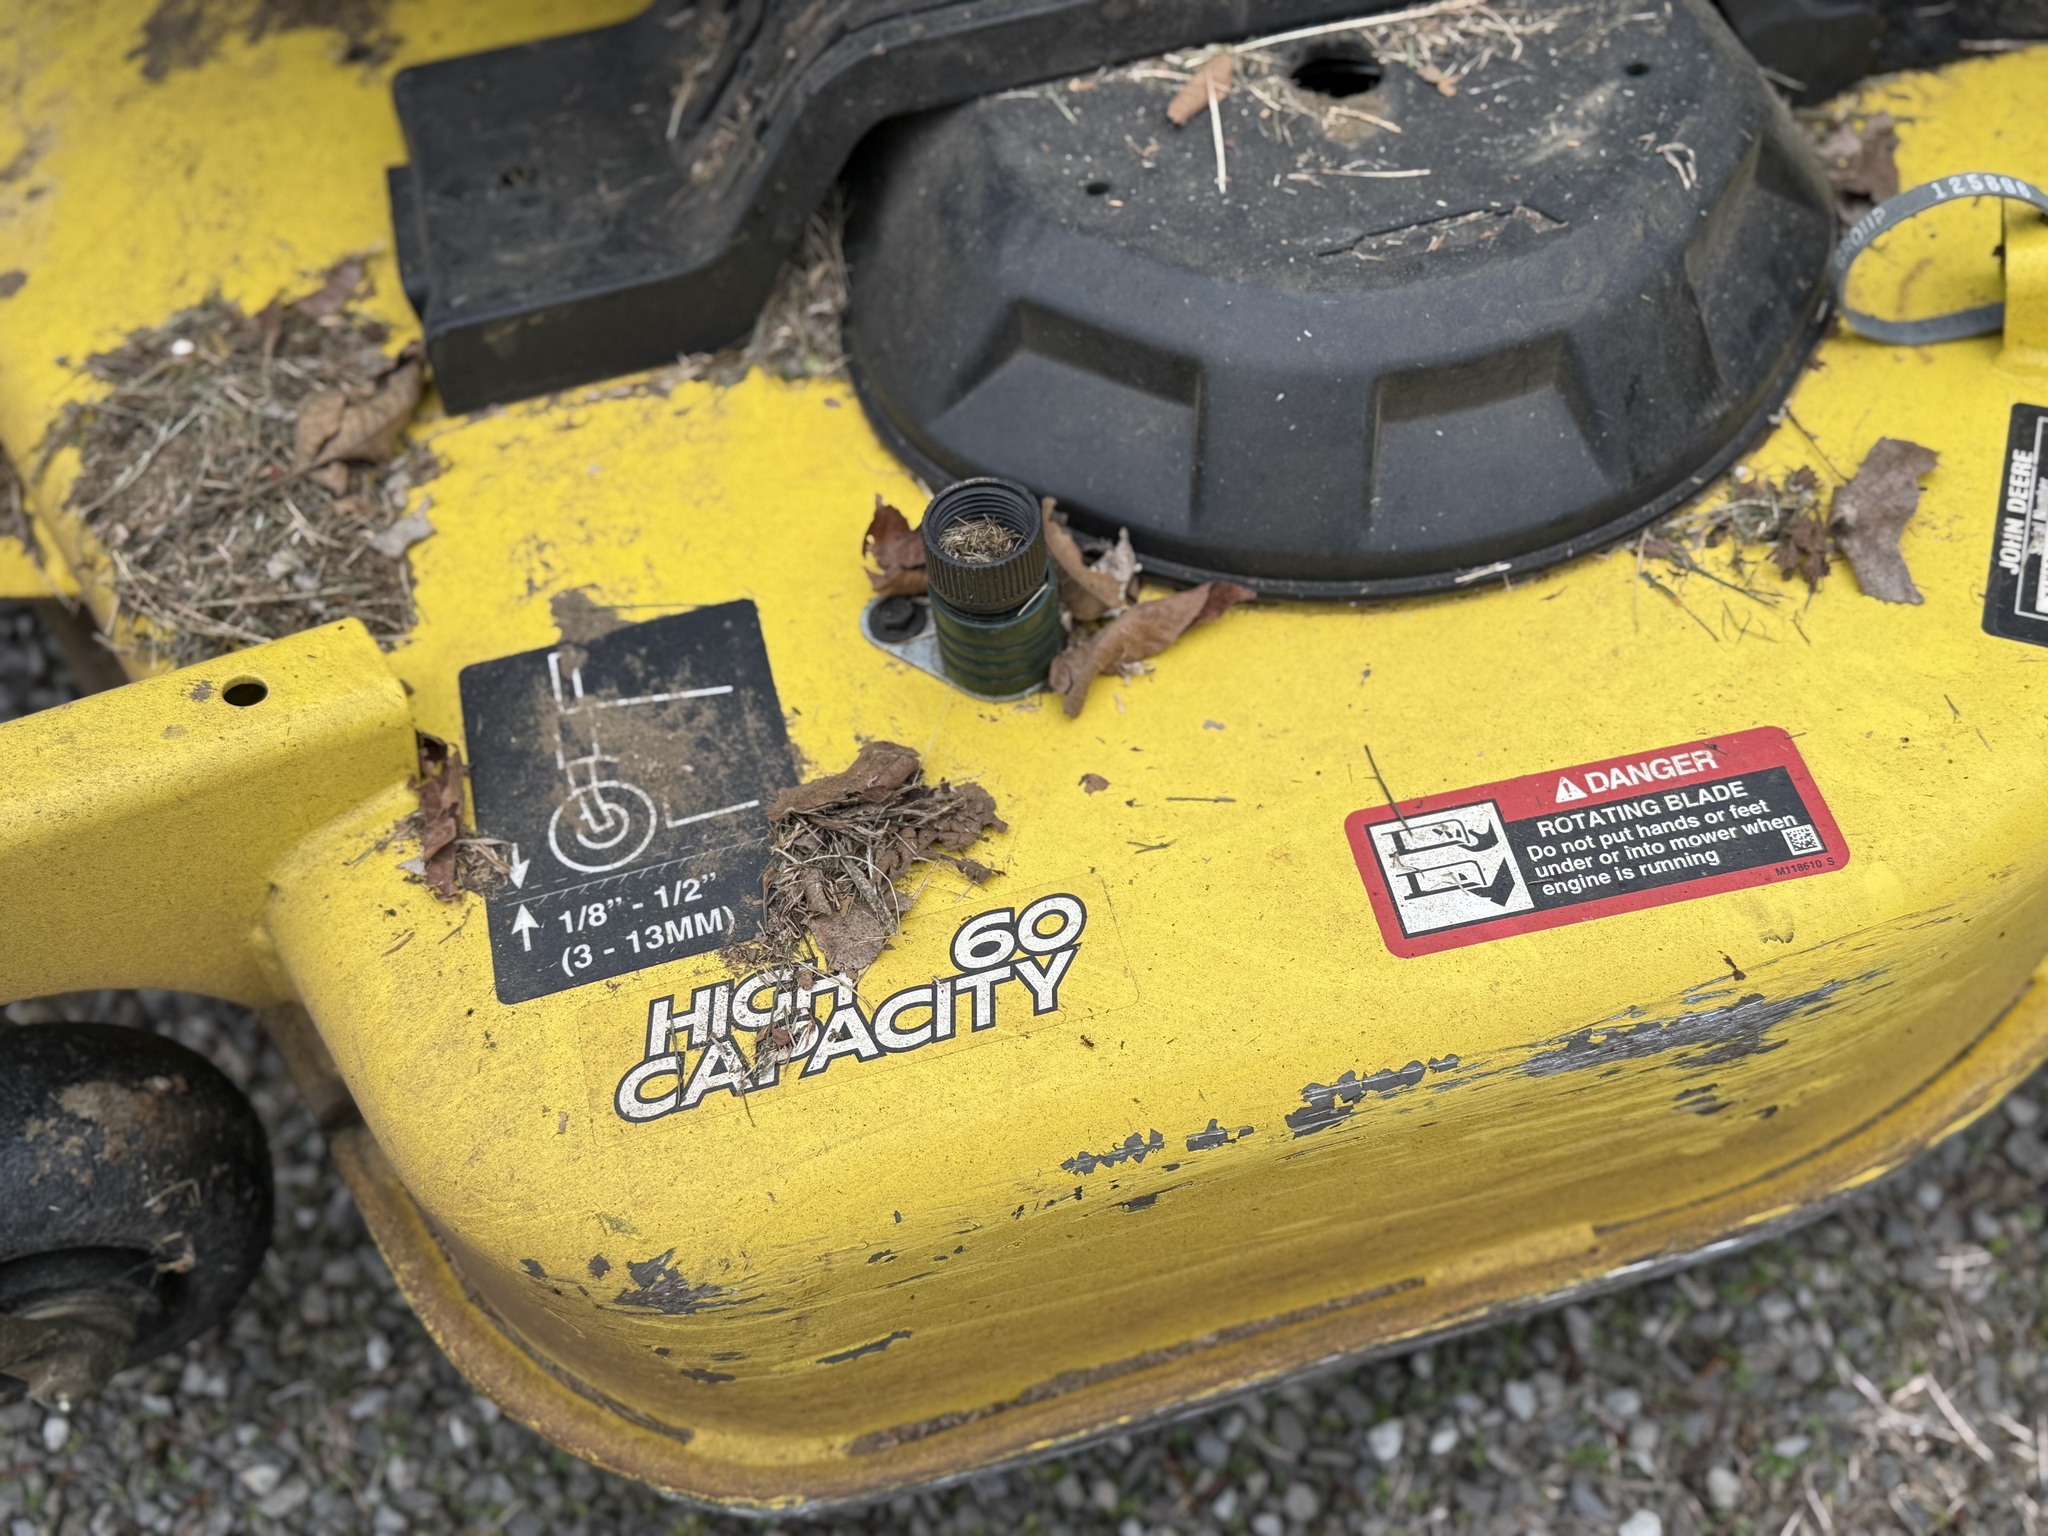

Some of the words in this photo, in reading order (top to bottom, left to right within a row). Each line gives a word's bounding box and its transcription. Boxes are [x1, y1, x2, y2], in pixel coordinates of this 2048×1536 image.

[2006, 448, 2033, 514] DEERE
[1998, 517, 2025, 576] JOHN
[1584, 749, 1719, 794] DANGER
[1527, 844, 1556, 862] Do
[1561, 834, 1596, 856] not
[1598, 826, 1634, 852] put
[1636, 812, 1700, 840] hands
[1704, 810, 1725, 825] or
[1728, 799, 1771, 820] feet
[1536, 795, 1661, 838] ROTATING
[1664, 780, 1749, 812] BLADE
[1534, 853, 1594, 879] under
[1599, 849, 1620, 865] or
[1625, 838, 1665, 859] into
[1669, 825, 1738, 851] mower
[1741, 813, 1798, 838] when
[1542, 871, 1612, 898] engine
[1614, 864, 1635, 881] is
[1639, 849, 1721, 877] running
[1775, 860, 1822, 876] M118610
[562, 943, 593, 977] (3
[626, 906, 735, 953] 13MM)
[950, 892, 1087, 974] 60
